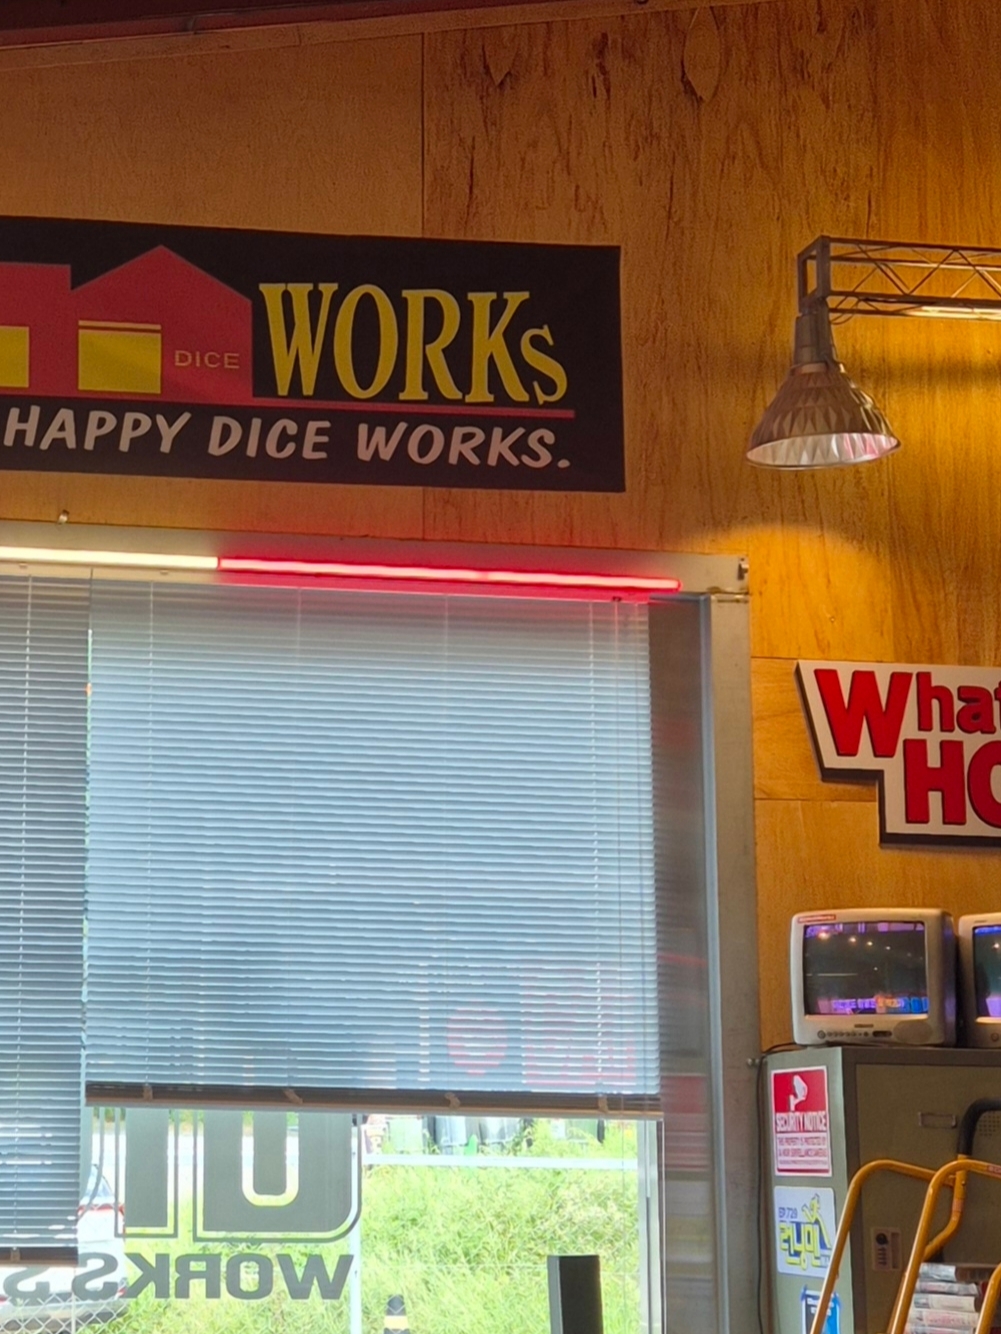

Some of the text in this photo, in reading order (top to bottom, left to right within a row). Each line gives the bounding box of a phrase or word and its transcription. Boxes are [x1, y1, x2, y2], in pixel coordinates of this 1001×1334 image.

[173, 350, 241, 370] DICE
[2, 405, 192, 455] HAPPY
[208, 415, 332, 460] DICE
[356, 422, 572, 469] WORKS.
[814, 668, 1001, 758] Wha
